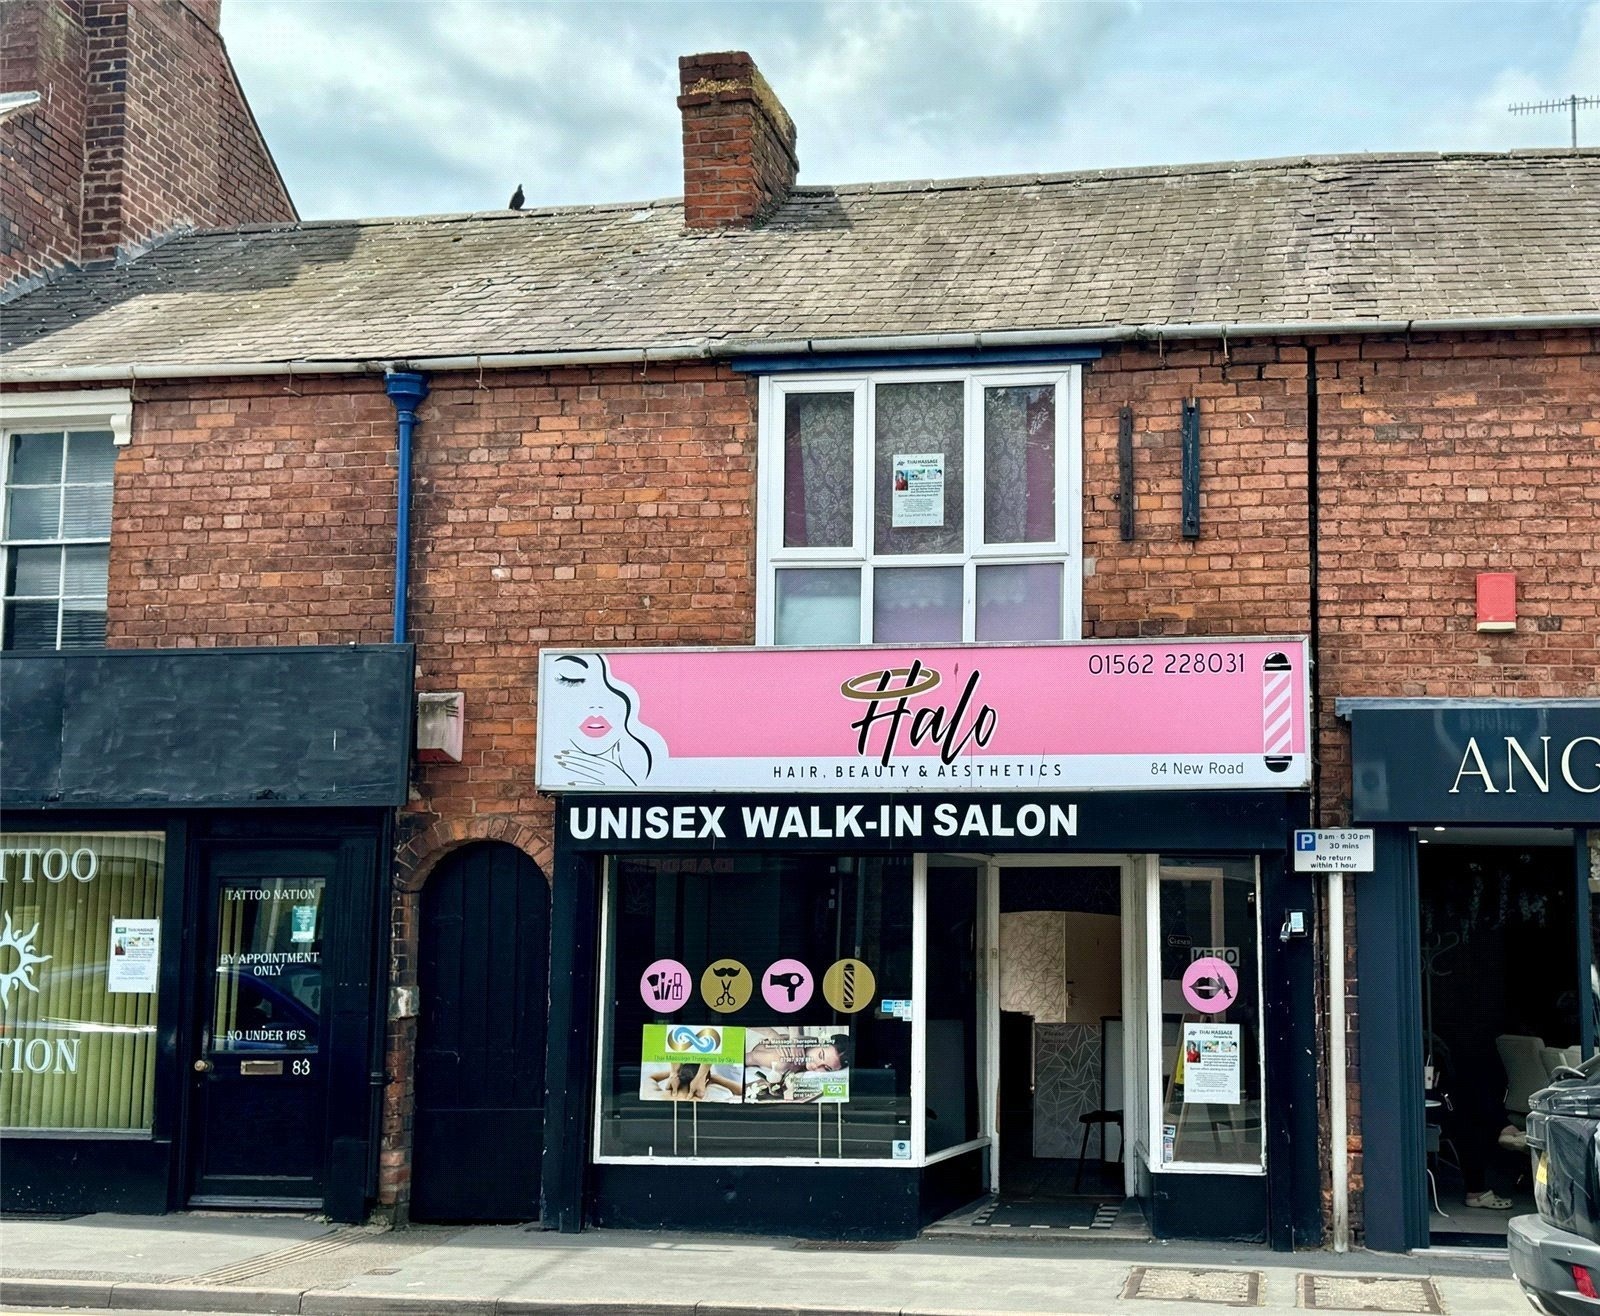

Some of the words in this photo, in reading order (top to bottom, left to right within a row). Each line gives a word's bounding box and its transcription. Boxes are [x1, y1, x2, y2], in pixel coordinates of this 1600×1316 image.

[1088, 654, 1154, 675] 01562
[1164, 652, 1244, 674] 228031
[851, 659, 996, 768] Halo
[773, 766, 826, 778] HAIR,
[835, 765, 909, 778] BEAUTY
[918, 765, 928, 777] &
[937, 763, 1062, 777] AESTHETICS
[1150, 762, 1168, 775] 84
[1173, 762, 1204, 775] New
[1209, 761, 1244, 775] Road
[1448, 736, 1600, 793] ANG
[569, 806, 726, 840] UNISEX
[741, 804, 922, 838] WALK-IN
[932, 803, 1078, 837] SALON
[1301, 834, 1314, 850] P
[1359, 834, 1371, 842] pm
[226, 889, 271, 900] TATTOO
[273, 888, 316, 900] NATION
[220, 952, 237, 965] BY
[238, 951, 320, 964] APPOINTMENT
[253, 964, 285, 977] ONLY
[227, 1030, 243, 1041] NO
[245, 1030, 284, 1041] UNDER
[286, 1030, 307, 1041] 16'S
[292, 1059, 311, 1075] 83
